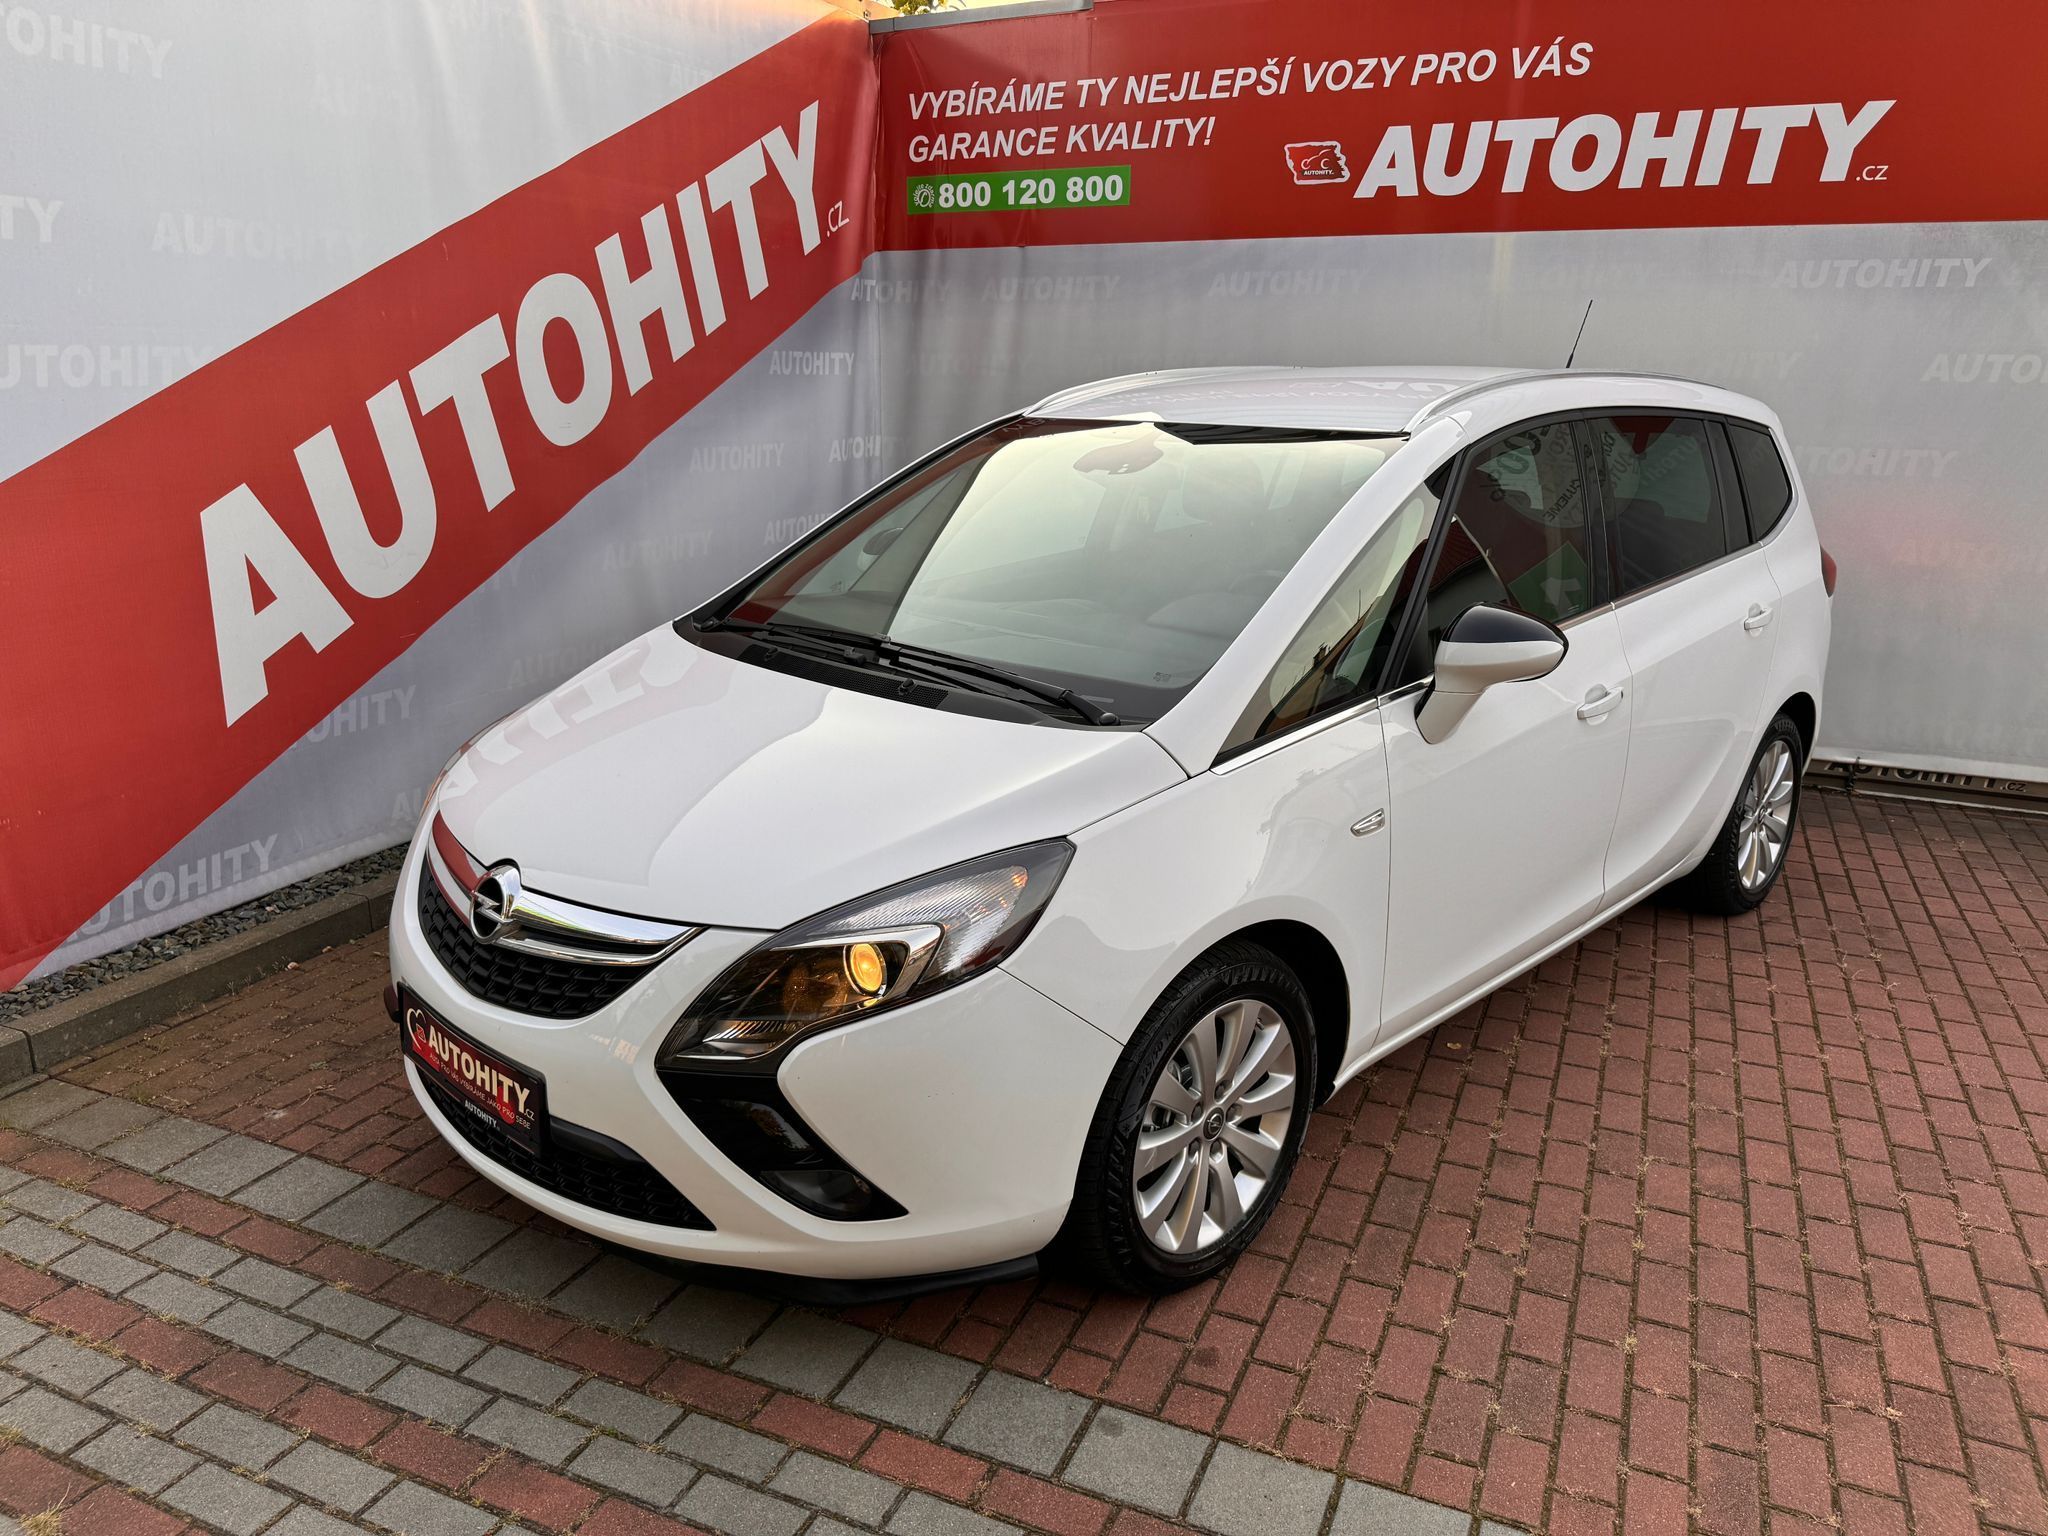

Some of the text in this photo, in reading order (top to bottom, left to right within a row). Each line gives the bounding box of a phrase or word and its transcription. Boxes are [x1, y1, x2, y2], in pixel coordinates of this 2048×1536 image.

[0, 6, 173, 79] OHITY
[908, 36, 1594, 120] VYBÍRÁME TY NEJLEPŠÍ VOZY PRO VÁS
[908, 116, 1216, 163] GARANCE KVALITY!
[938, 175, 1123, 208] 800 120 800
[979, 275, 1121, 302] AUTOHITY
[1208, 269, 1368, 298] AUTOHITY
[1771, 257, 1993, 289] AUTOHITY
[769, 351, 854, 377] AUTOHITY
[689, 442, 785, 476] AUTOHITY
[1796, 446, 1960, 478] TOHITY
[602, 528, 713, 573] AUTOHITY
[502, 1105, 515, 1120] PRO
[515, 1114, 531, 1130] SEBE
